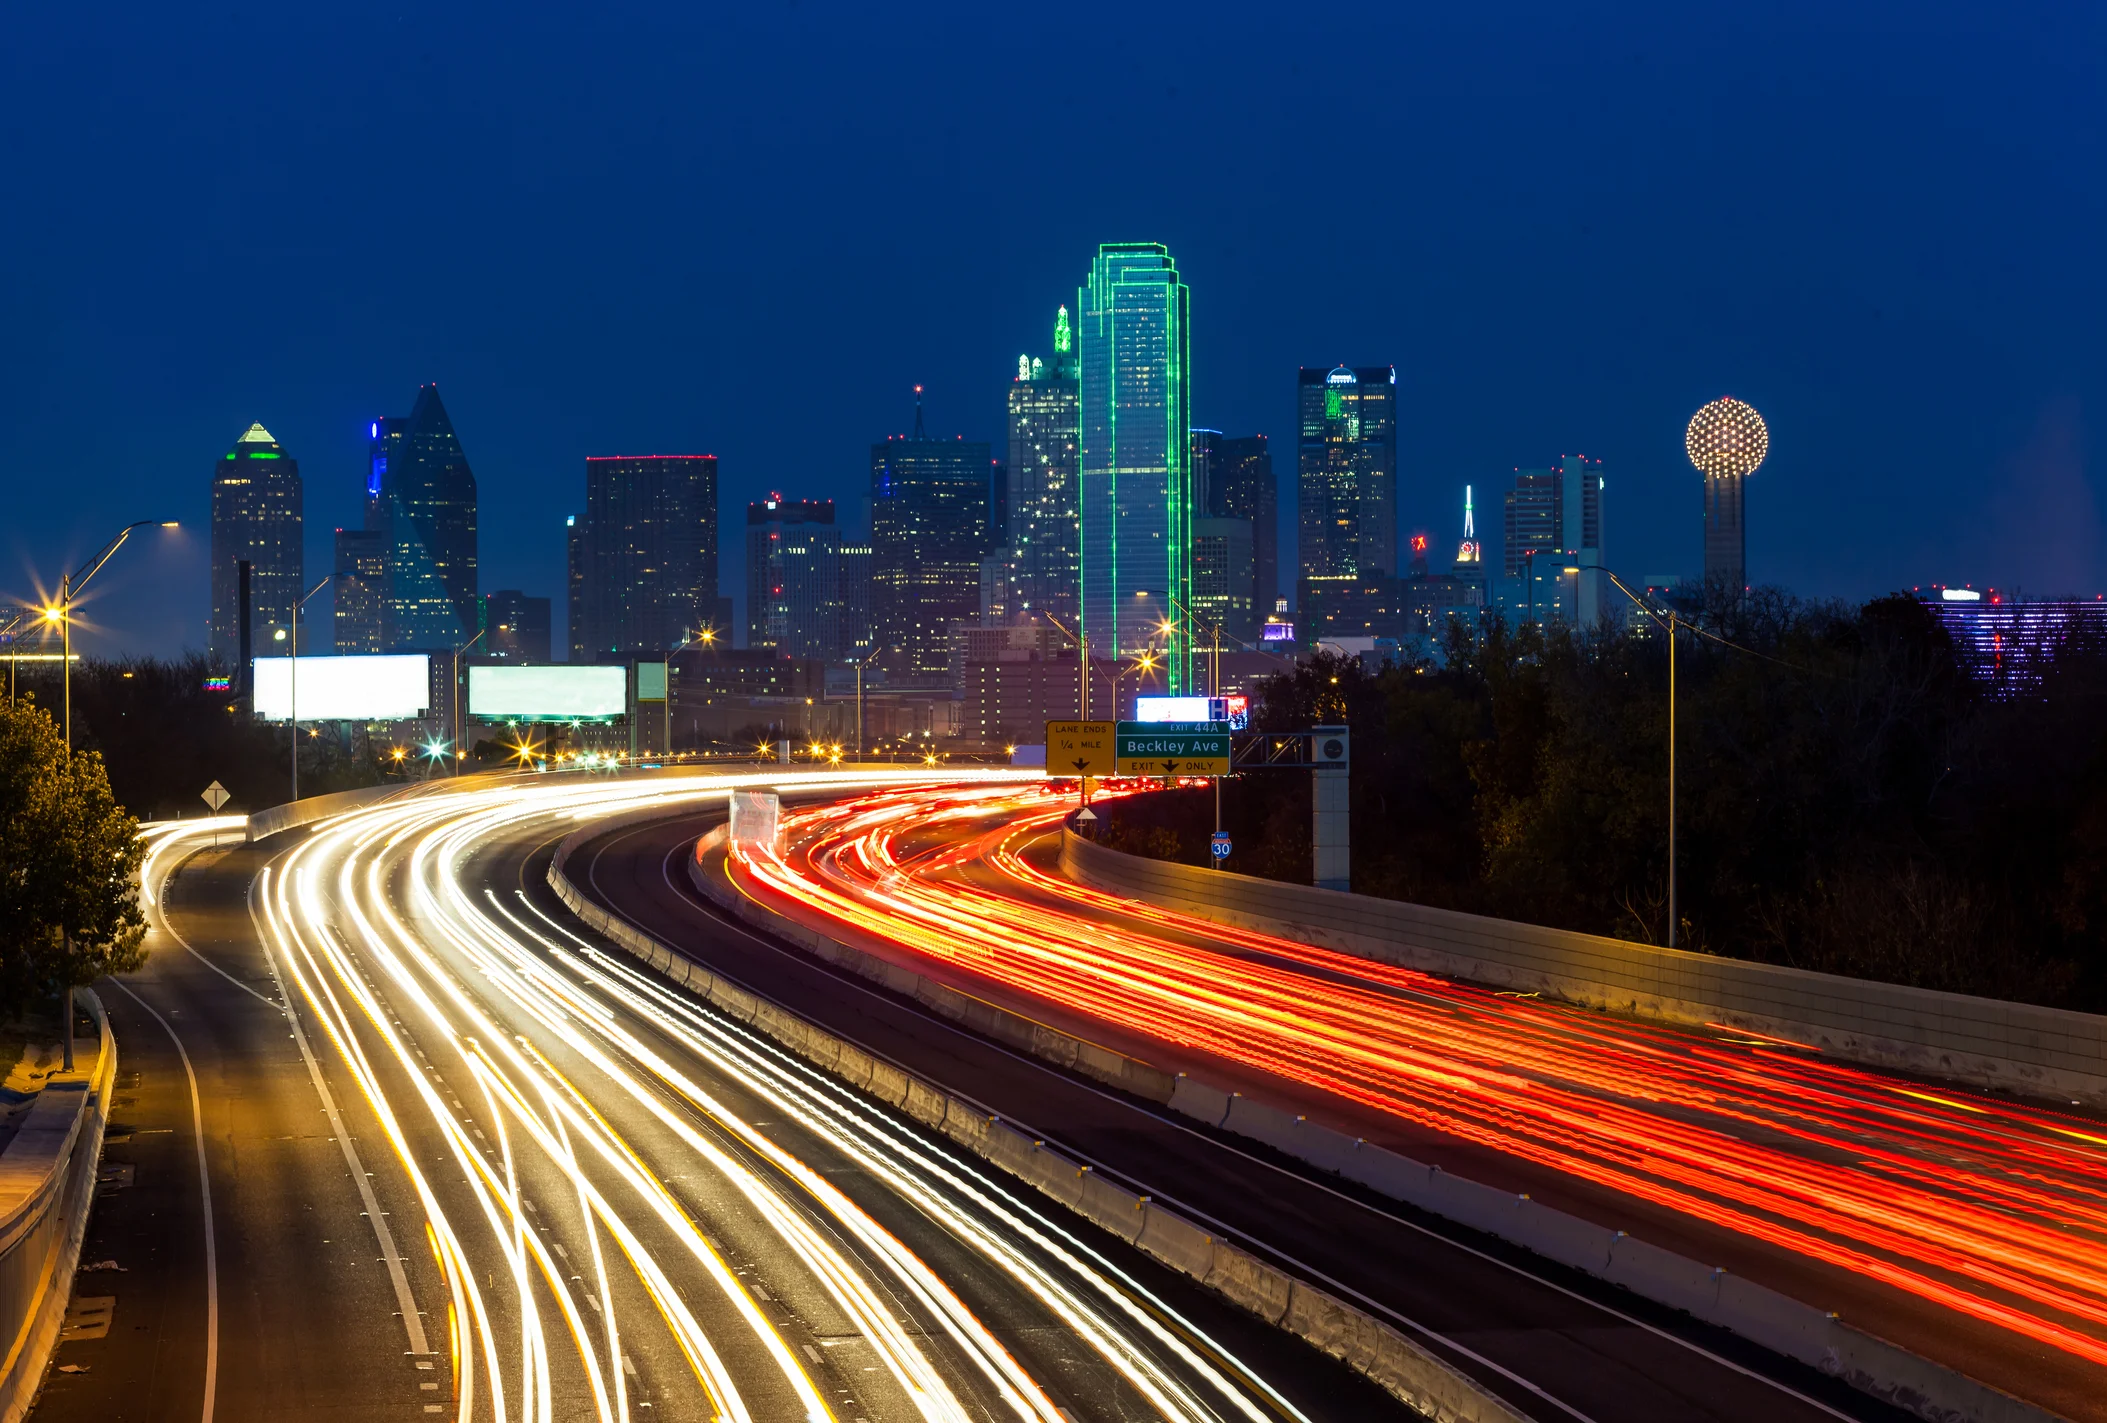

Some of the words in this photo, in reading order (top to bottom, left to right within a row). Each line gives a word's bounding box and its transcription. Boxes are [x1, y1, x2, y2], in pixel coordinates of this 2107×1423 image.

[1211, 700, 1226, 719] H
[1055, 725, 1079, 733] LANE
[1083, 725, 1107, 733] ENDS
[1194, 722, 1219, 733] 44A
[1080, 741, 1101, 749] MILE
[1127, 740, 1185, 755] Beckley
[1192, 741, 1219, 752] Ave
[1131, 762, 1155, 771] EXIT
[1185, 762, 1214, 771] ONLY
[1214, 844, 1230, 855] 30
